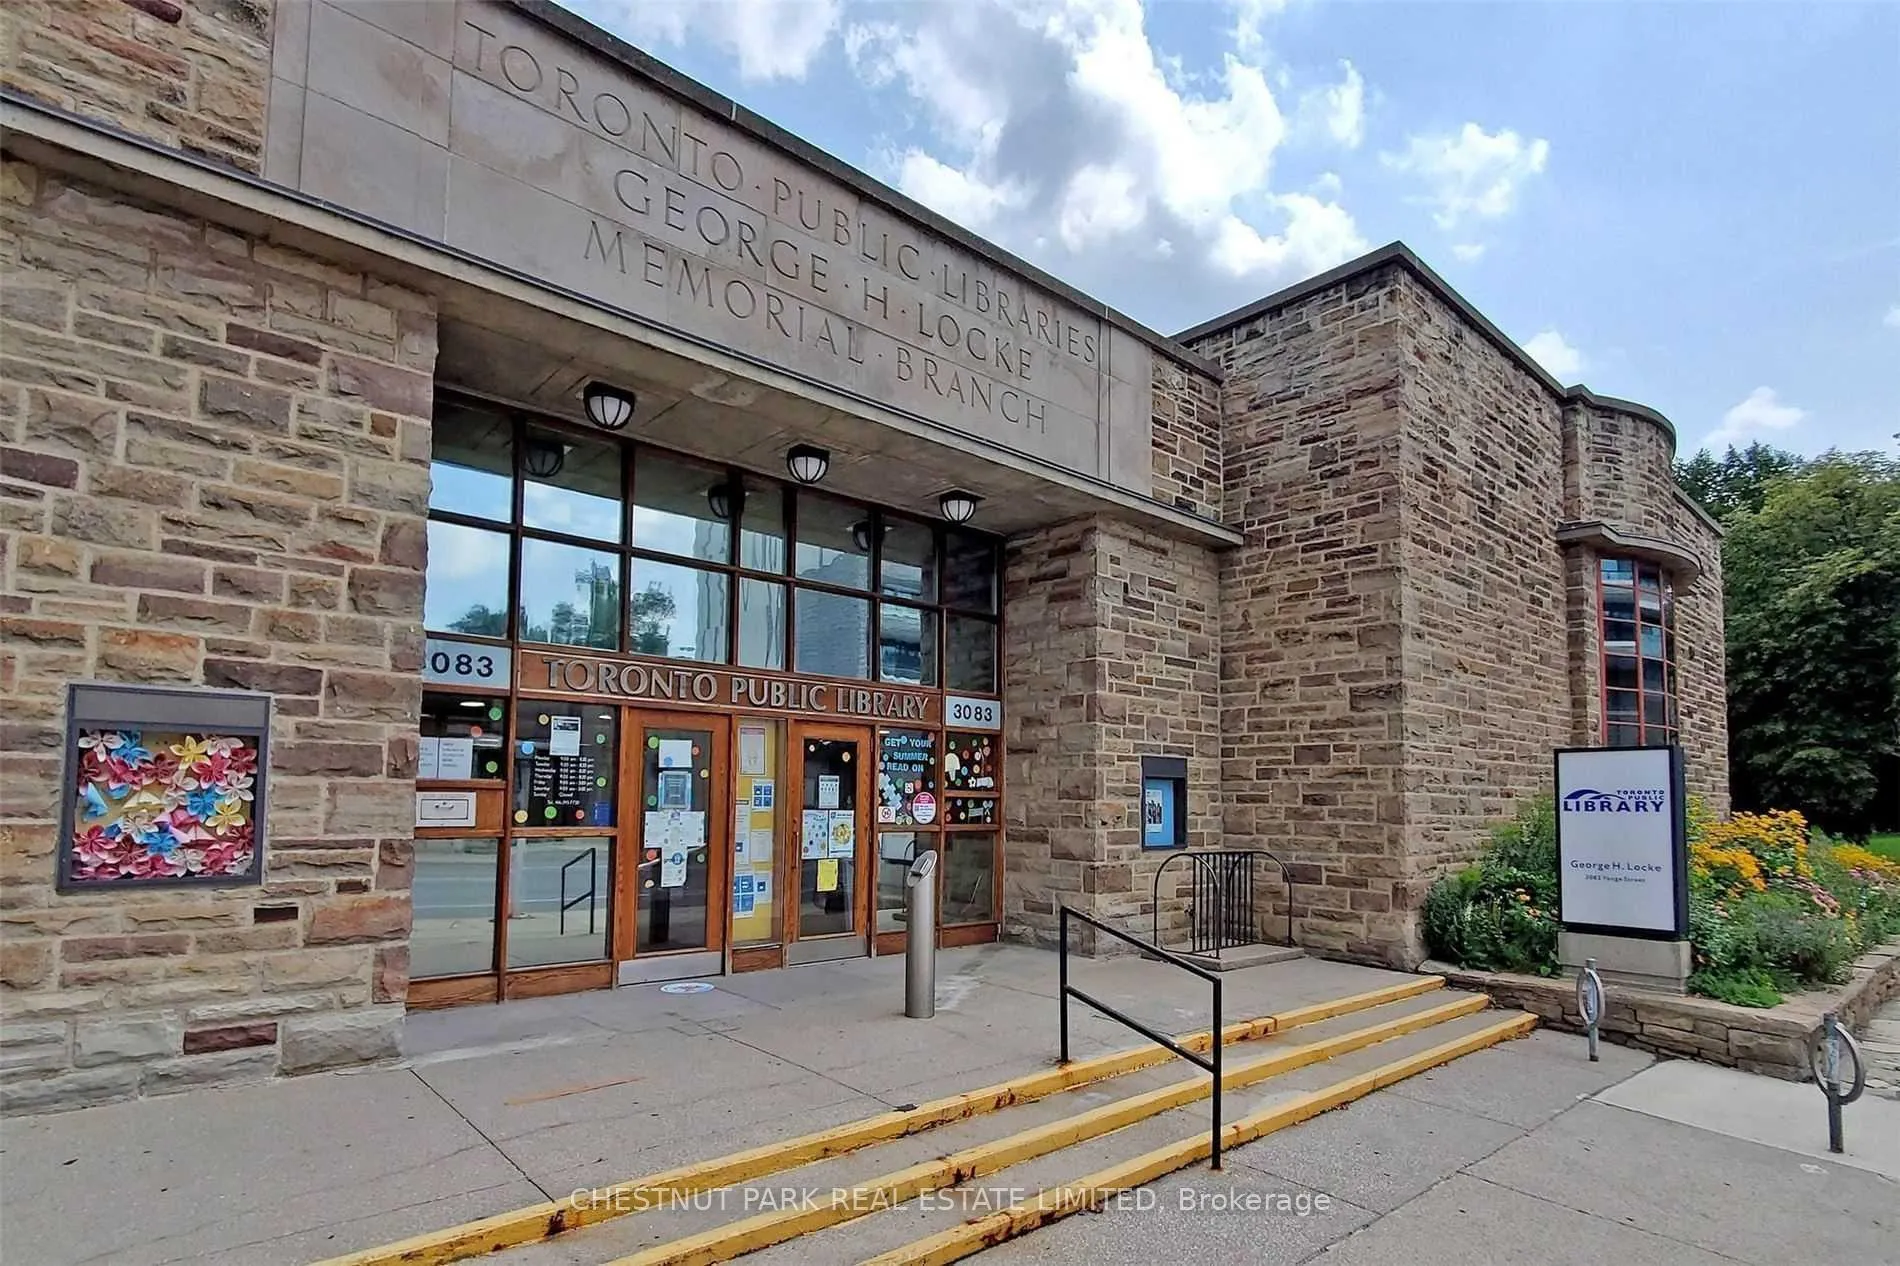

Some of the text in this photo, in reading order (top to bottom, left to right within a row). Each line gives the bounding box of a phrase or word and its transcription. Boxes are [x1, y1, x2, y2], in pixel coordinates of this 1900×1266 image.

[464, 20, 1096, 364] TORONTO PUBLIC LIBRARIES
[613, 168, 1033, 381] GEORGE H LOCKE
[583, 220, 1047, 436] MEMORIAL BRANCH
[424, 652, 494, 678] 083
[543, 656, 929, 720] TORONTO PUBLIC LIBRARY
[953, 703, 993, 722] 3083
[884, 737, 932, 748] GET YOUR
[893, 751, 929, 762] SUMMER
[886, 762, 924, 772] READ ON
[1563, 800, 1664, 812] LIBRARY
[1570, 860, 1610, 872] George
[1627, 862, 1662, 872] Locke
